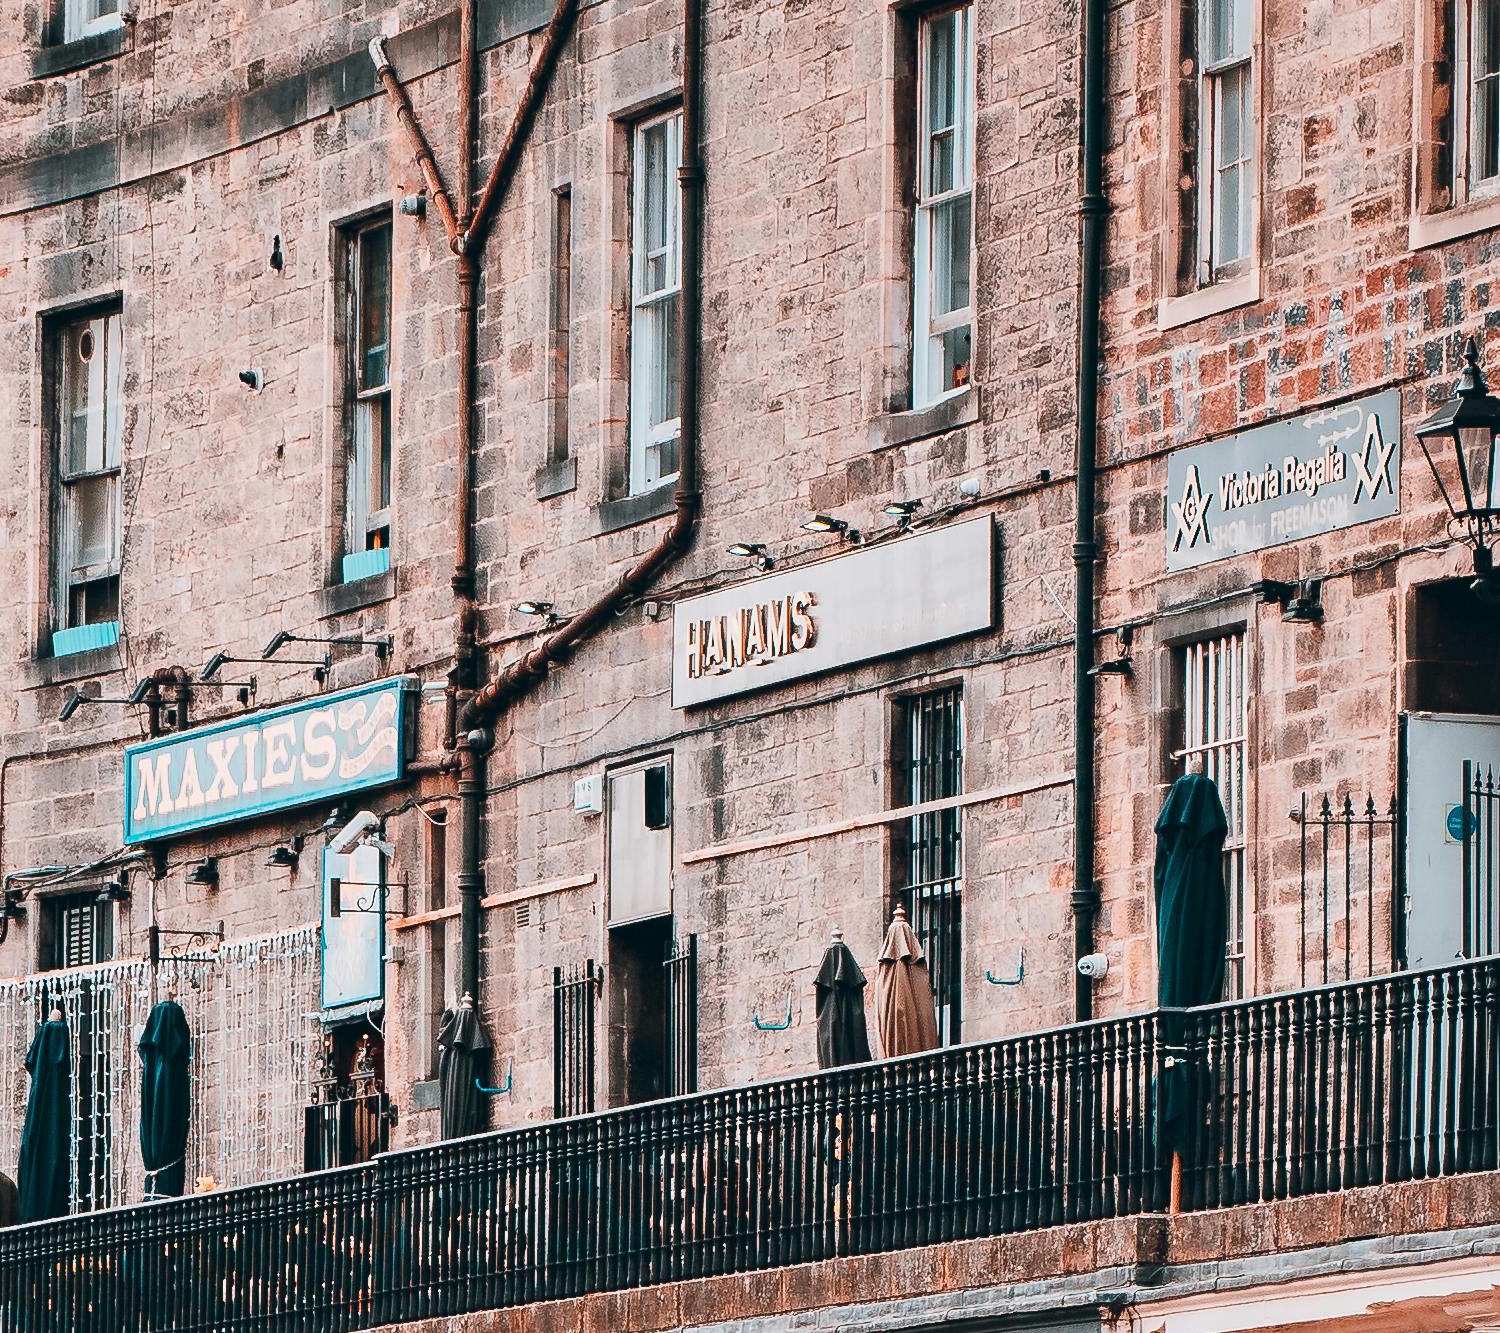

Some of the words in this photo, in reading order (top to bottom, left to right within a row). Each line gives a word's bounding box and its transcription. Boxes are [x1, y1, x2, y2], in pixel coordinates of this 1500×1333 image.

[1219, 463, 1281, 512] Victoria
[1284, 445, 1346, 497] Regalia
[688, 591, 818, 678] HANAMS
[133, 709, 337, 821] MAXIES
